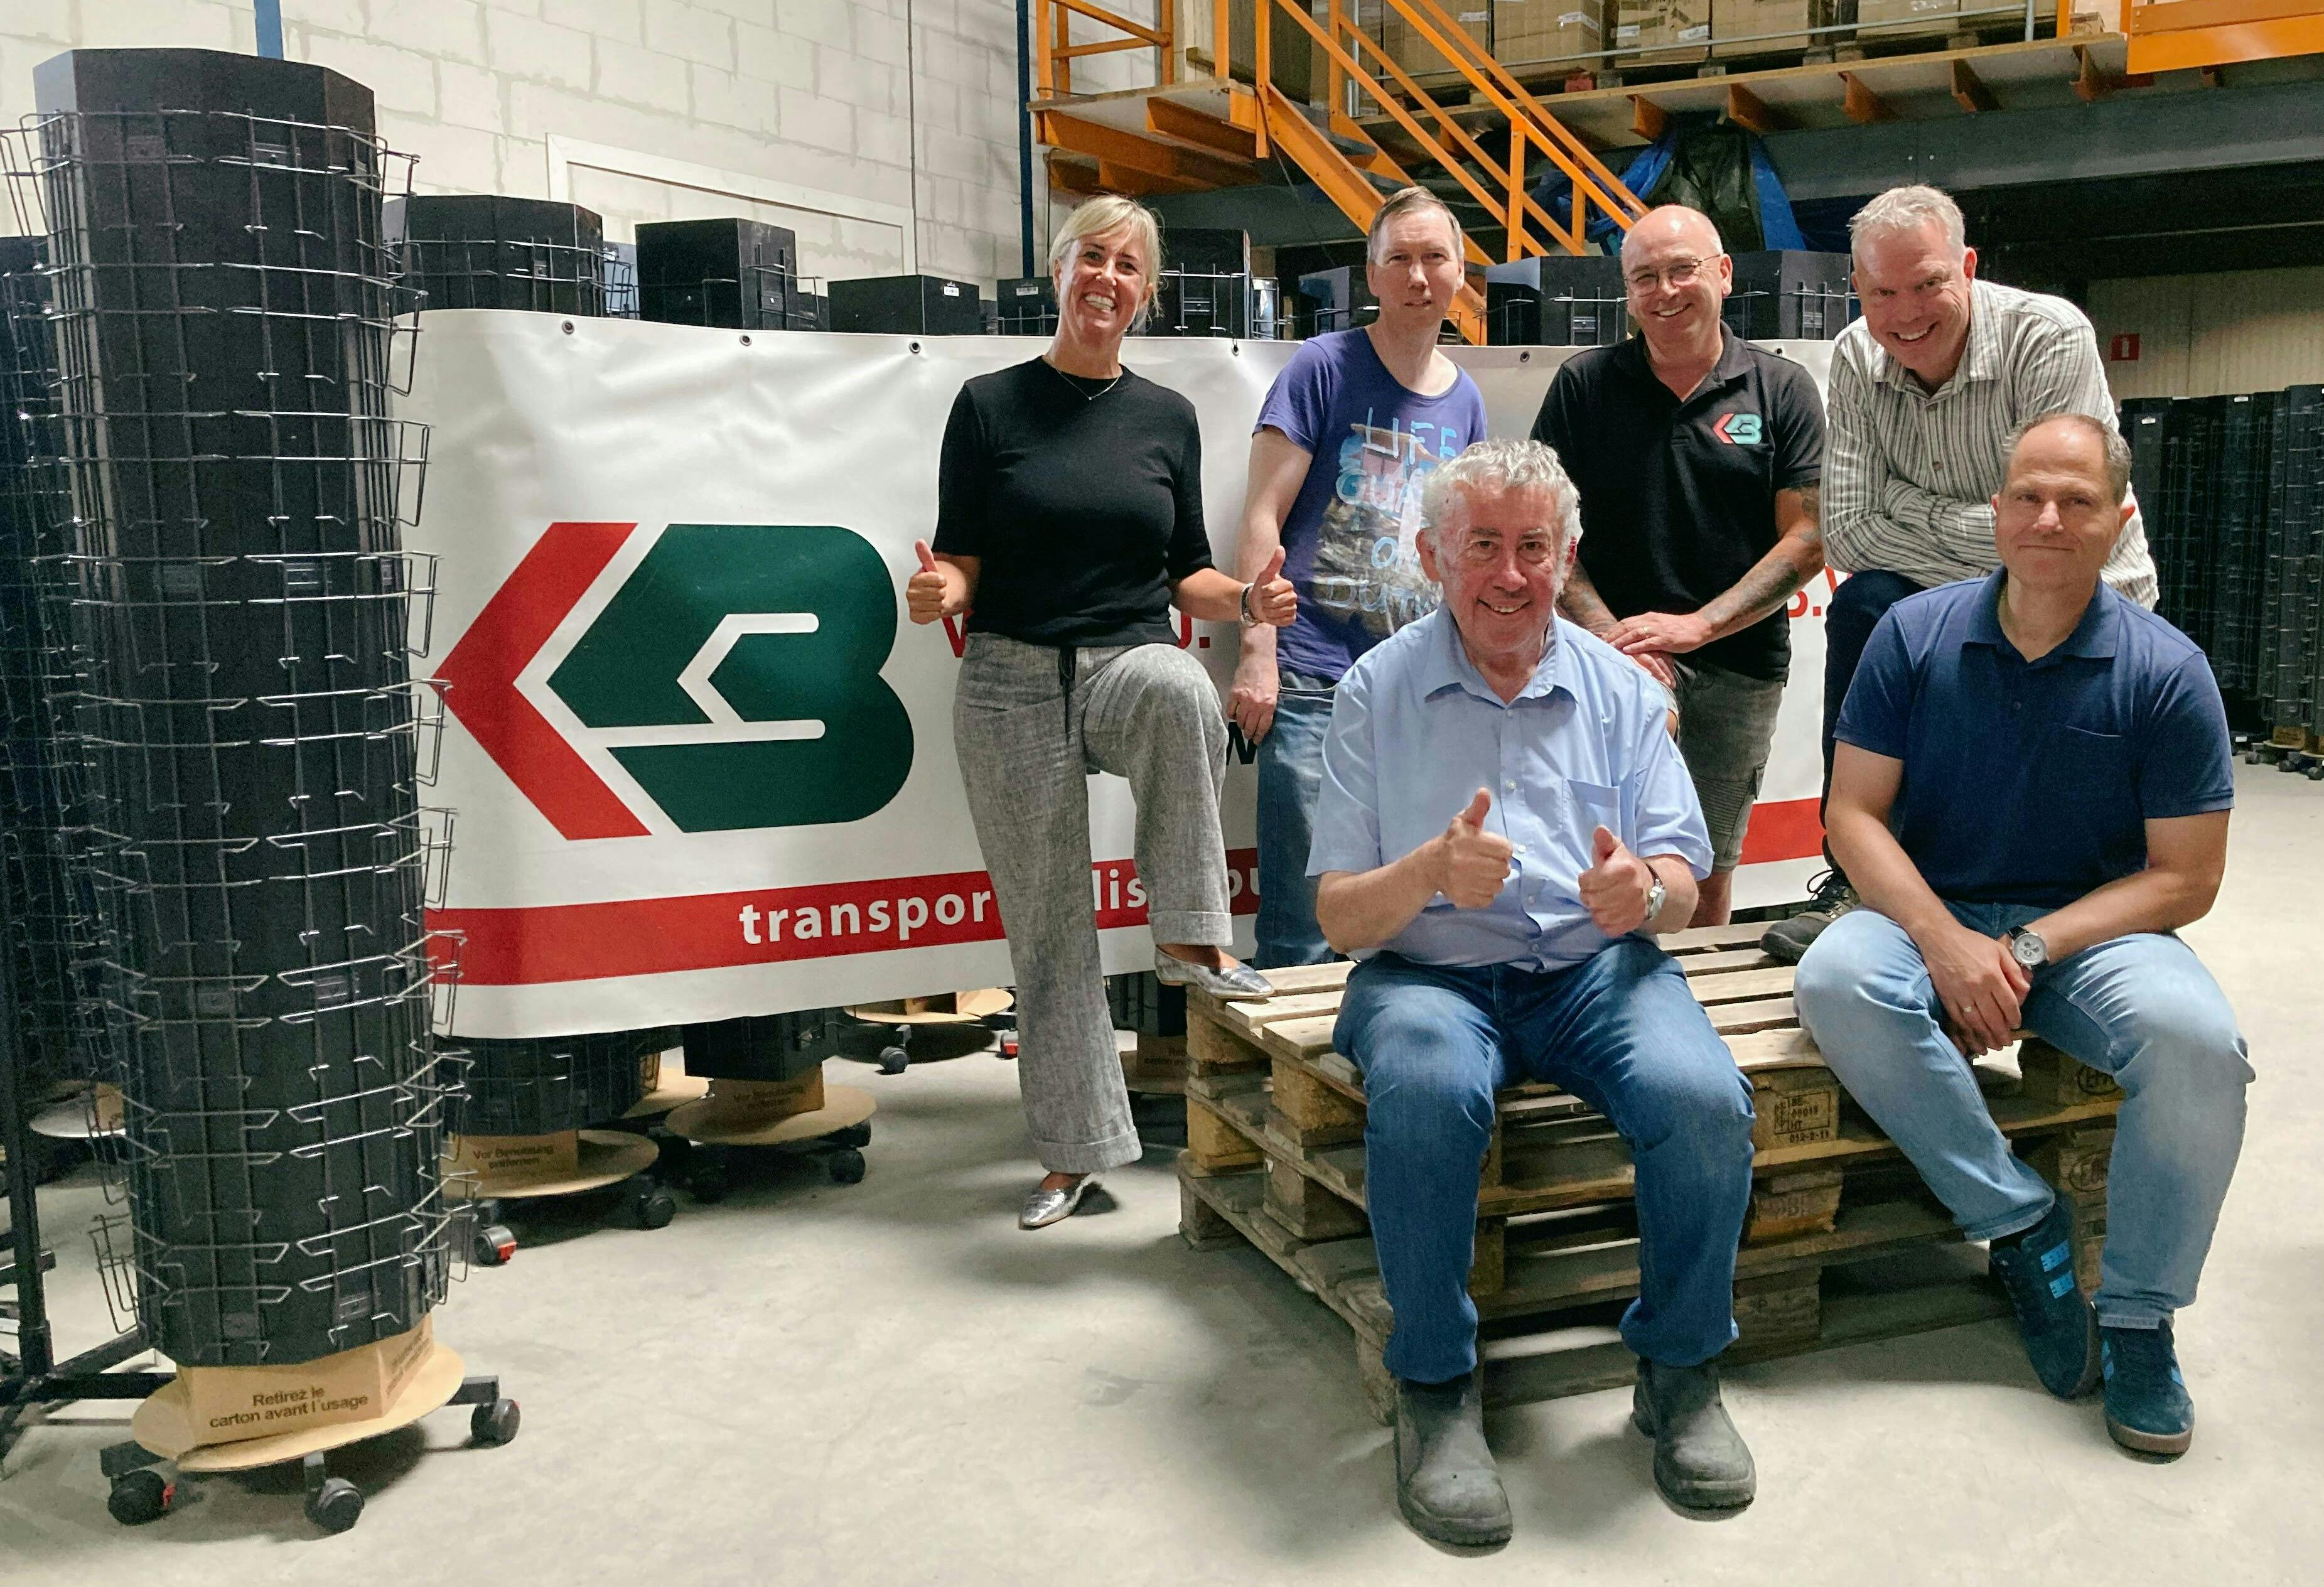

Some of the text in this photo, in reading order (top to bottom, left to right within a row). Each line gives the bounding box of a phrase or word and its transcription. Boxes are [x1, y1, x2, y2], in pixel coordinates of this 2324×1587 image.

[1361, 407, 1458, 465] LIFE
[1335, 467, 1423, 515] GUA
[739, 890, 991, 944] transpor
[209, 1411, 261, 1429] carton
[264, 1402, 308, 1421] avant
[252, 1389, 308, 1407] Retirez
